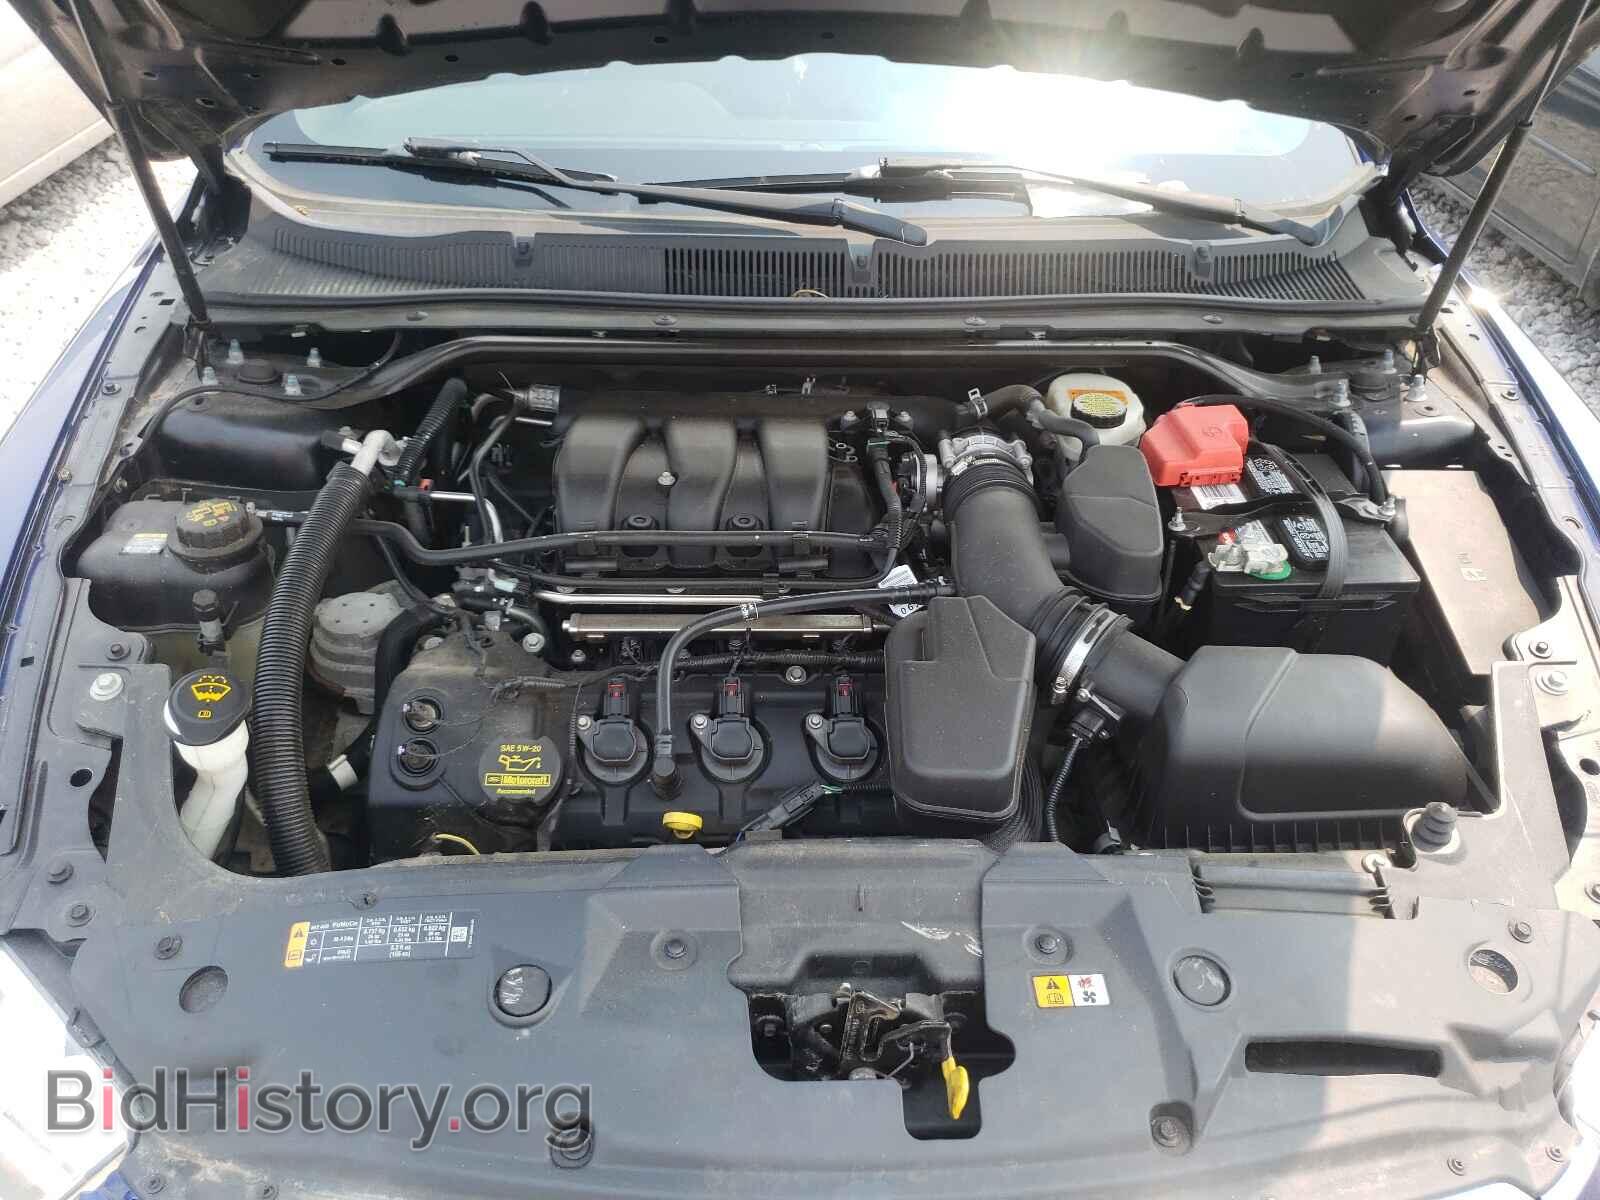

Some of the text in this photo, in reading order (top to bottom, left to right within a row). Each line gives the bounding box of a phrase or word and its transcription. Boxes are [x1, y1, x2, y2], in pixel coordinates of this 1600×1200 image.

[500, 744, 542, 753] SAE 5W-20
[502, 775, 549, 785] Motorcraft
